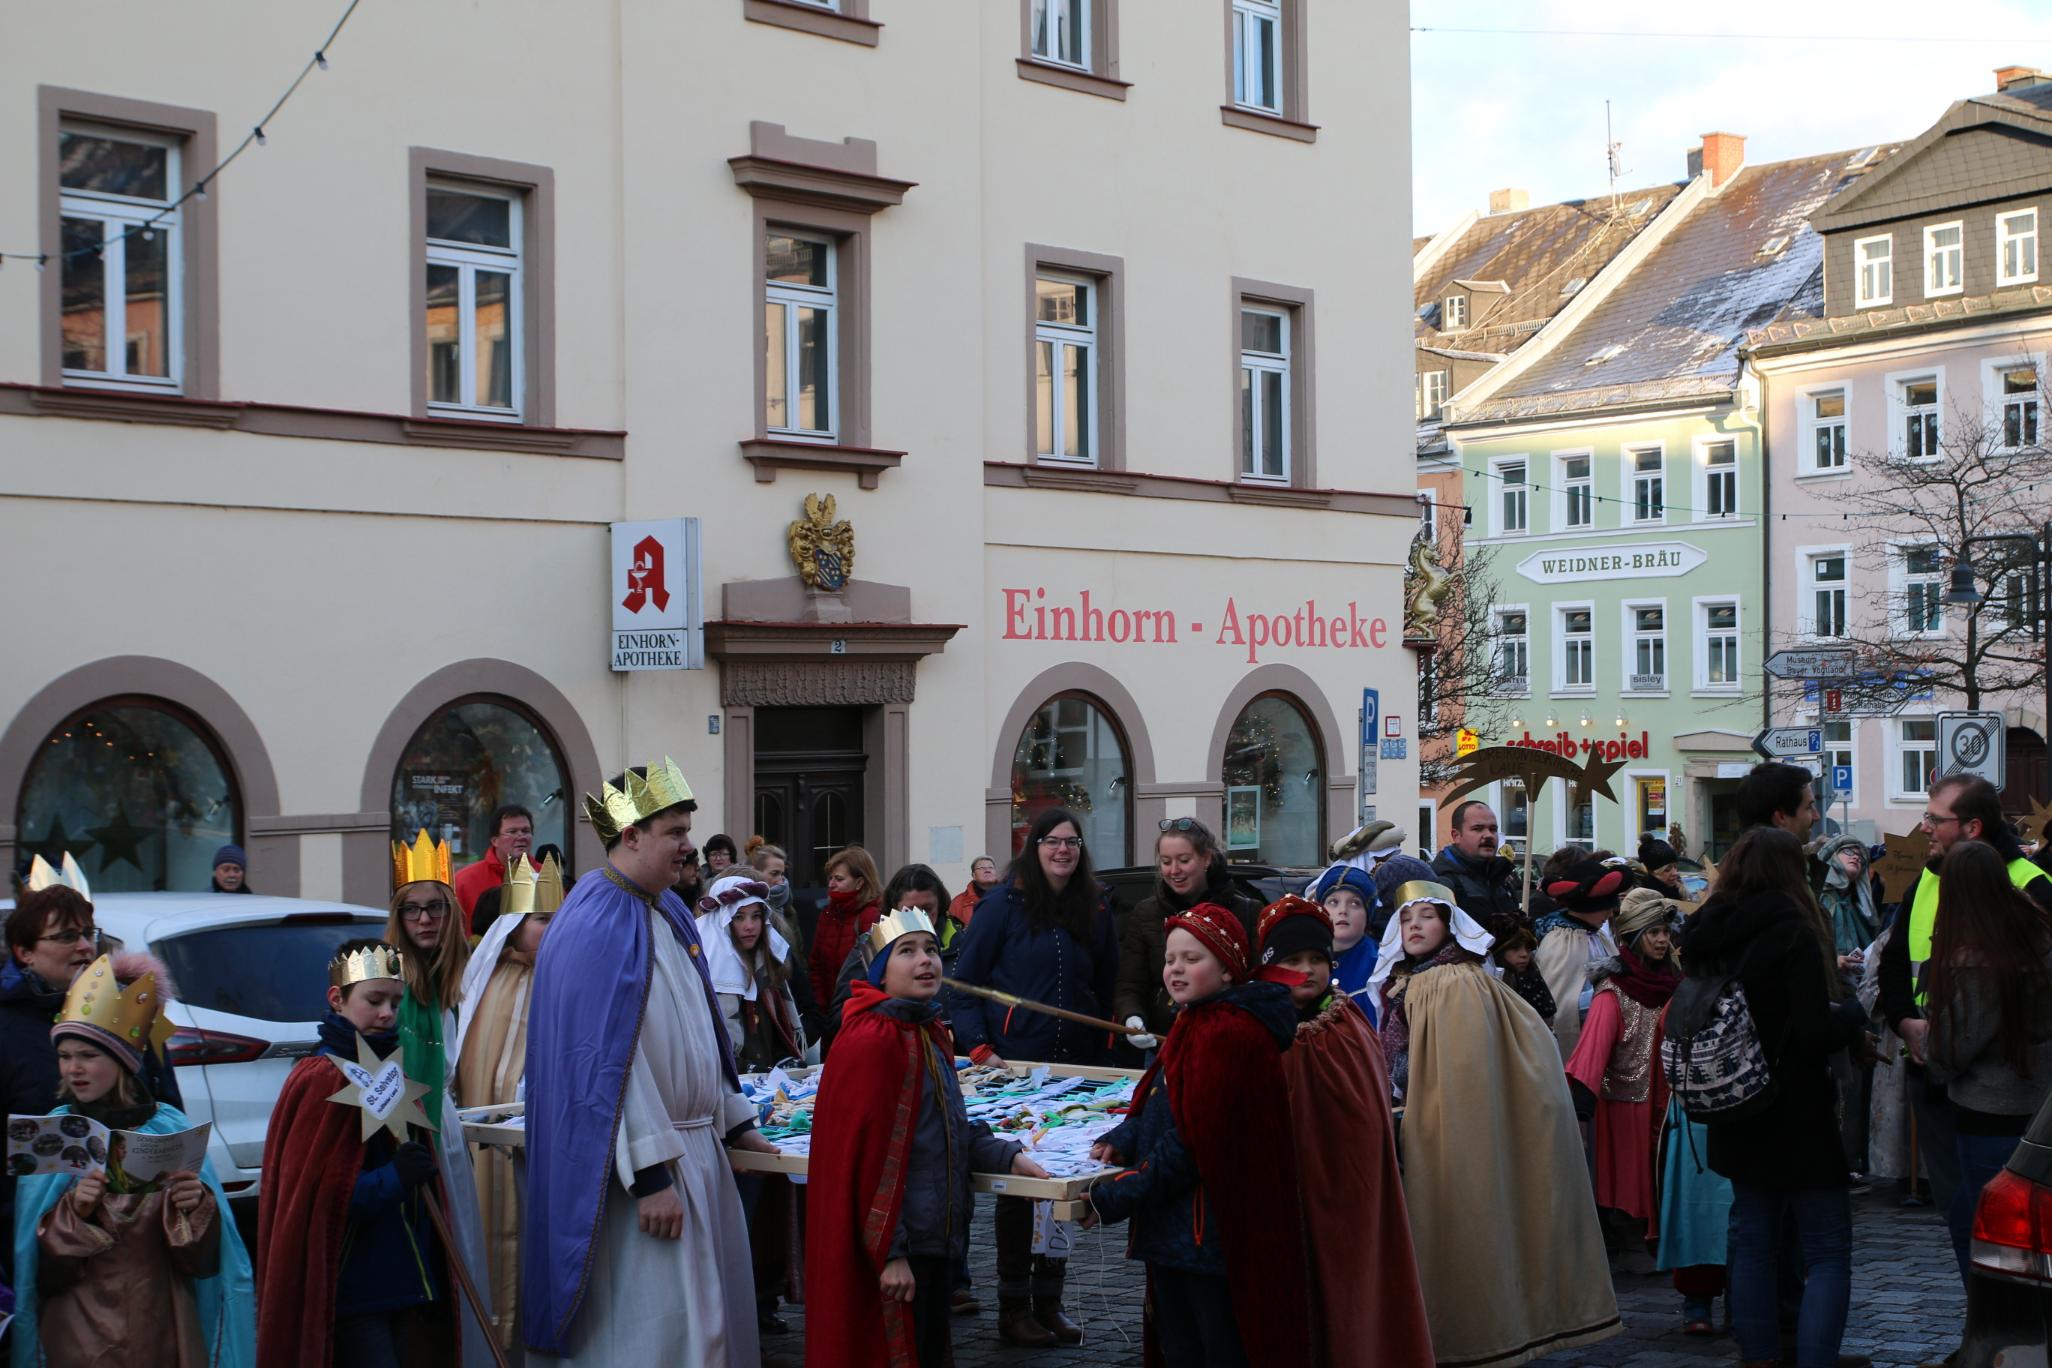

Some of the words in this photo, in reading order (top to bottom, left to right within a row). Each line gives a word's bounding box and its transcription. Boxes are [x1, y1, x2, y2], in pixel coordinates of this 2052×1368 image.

[1542, 550, 1681, 574] WEIDNER-BRÄU
[1002, 587, 1178, 643] Einhorn
[1216, 597, 1387, 663] Apotheke
[618, 633, 680, 650] EINHORN-
[834, 640, 842, 652] 2
[614, 650, 682, 667] APOTHEKE
[1786, 655, 1817, 664] Museum
[1633, 674, 1661, 685] sisley
[1366, 696, 1375, 739] P
[1596, 731, 1649, 762] spiel
[1776, 736, 1807, 748] Rathaus
[411, 775, 437, 784] STARK
[1837, 769, 1848, 787] P
[433, 785, 464, 794] INFEKT
[374, 1067, 399, 1095] Salvator
